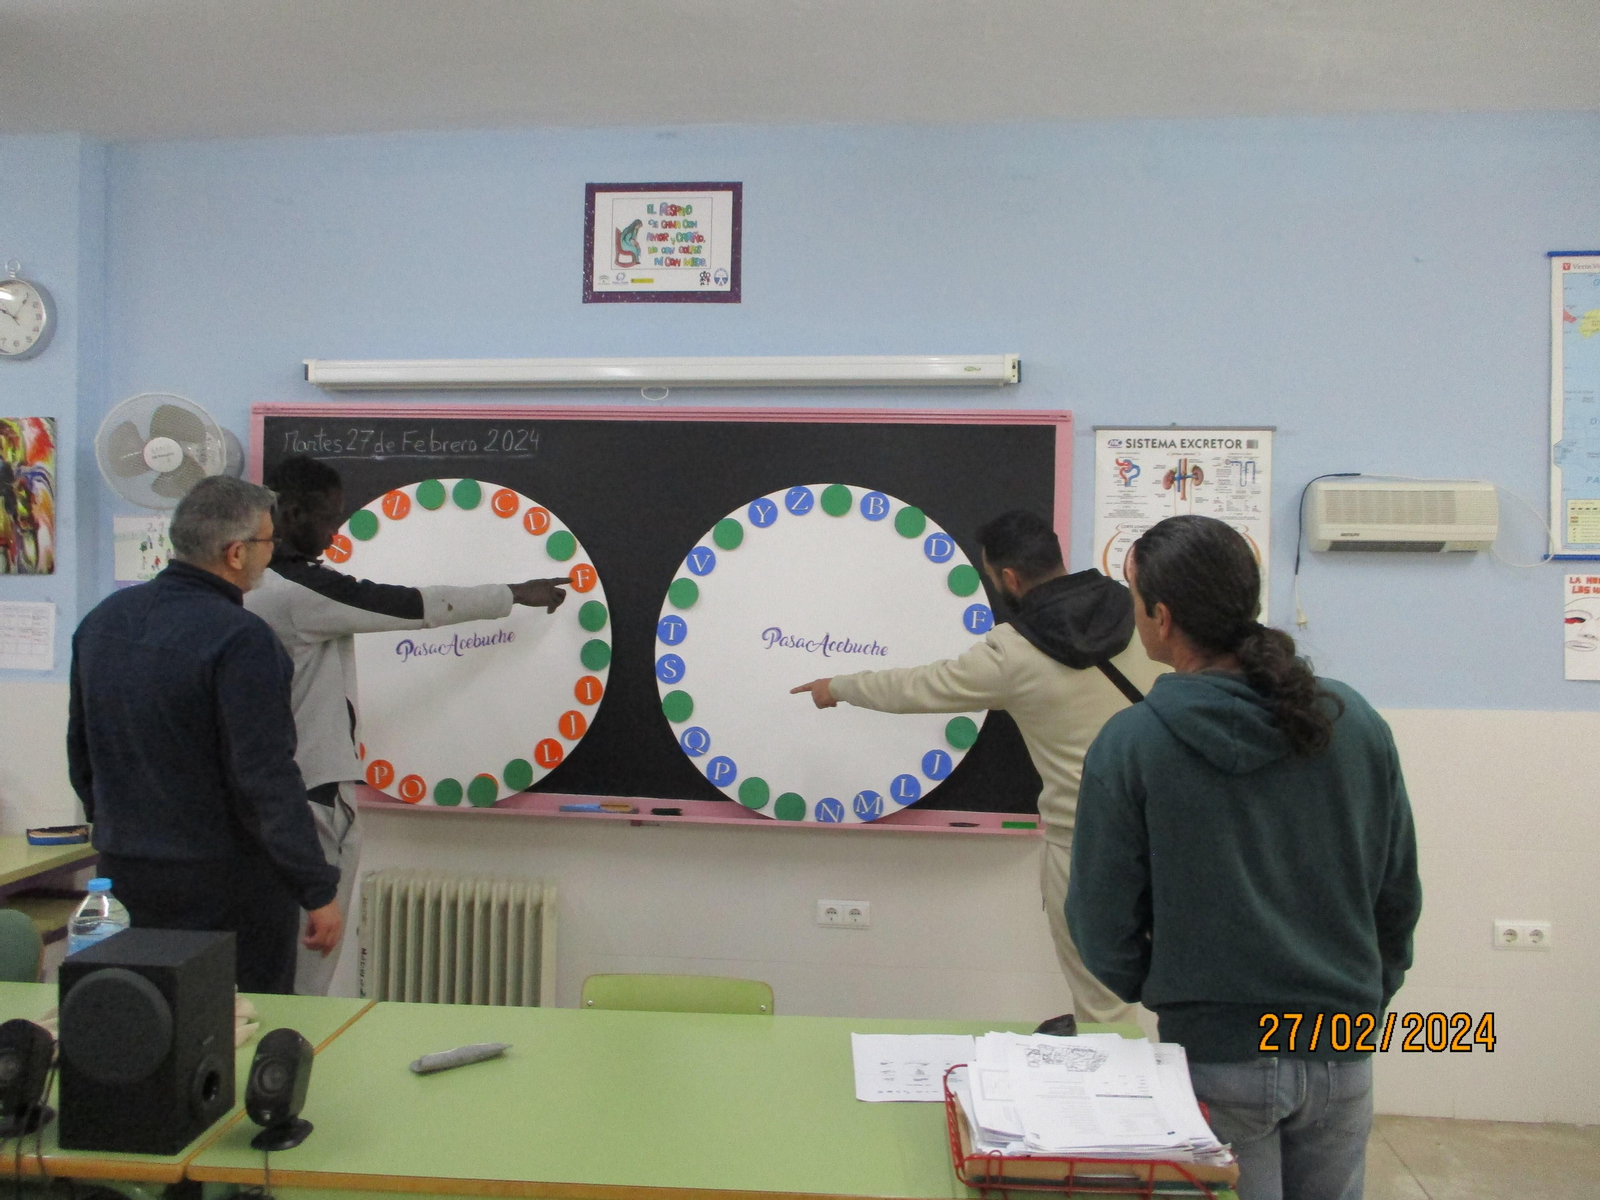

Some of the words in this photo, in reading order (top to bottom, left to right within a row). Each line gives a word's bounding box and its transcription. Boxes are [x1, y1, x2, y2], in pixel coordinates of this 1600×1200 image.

[284, 427, 342, 453] Martes
[346, 428, 374, 452] 27
[374, 428, 396, 453] de
[401, 428, 477, 452] Febrero
[484, 428, 540, 452] 2024
[1125, 438, 1177, 449] SISTEMA
[1180, 438, 1243, 449] EXCRETOR
[386, 495, 407, 515] Z
[494, 493, 514, 513] C
[790, 491, 809, 511] Z
[867, 496, 885, 516] B
[528, 510, 548, 531] D
[754, 505, 772, 524] Y
[929, 538, 951, 558] D
[691, 553, 711, 573] V
[576, 568, 591, 589] F
[970, 610, 988, 629] F
[663, 621, 682, 641] T
[662, 659, 678, 679] S
[584, 681, 593, 700] I
[569, 714, 576, 737] J
[683, 730, 706, 755] Q
[543, 744, 559, 763] L
[713, 761, 730, 781] P
[930, 753, 942, 775] J
[373, 765, 389, 785] P
[401, 779, 423, 798] O
[898, 777, 915, 798] L
[818, 802, 842, 823] N
[855, 794, 884, 816] M
